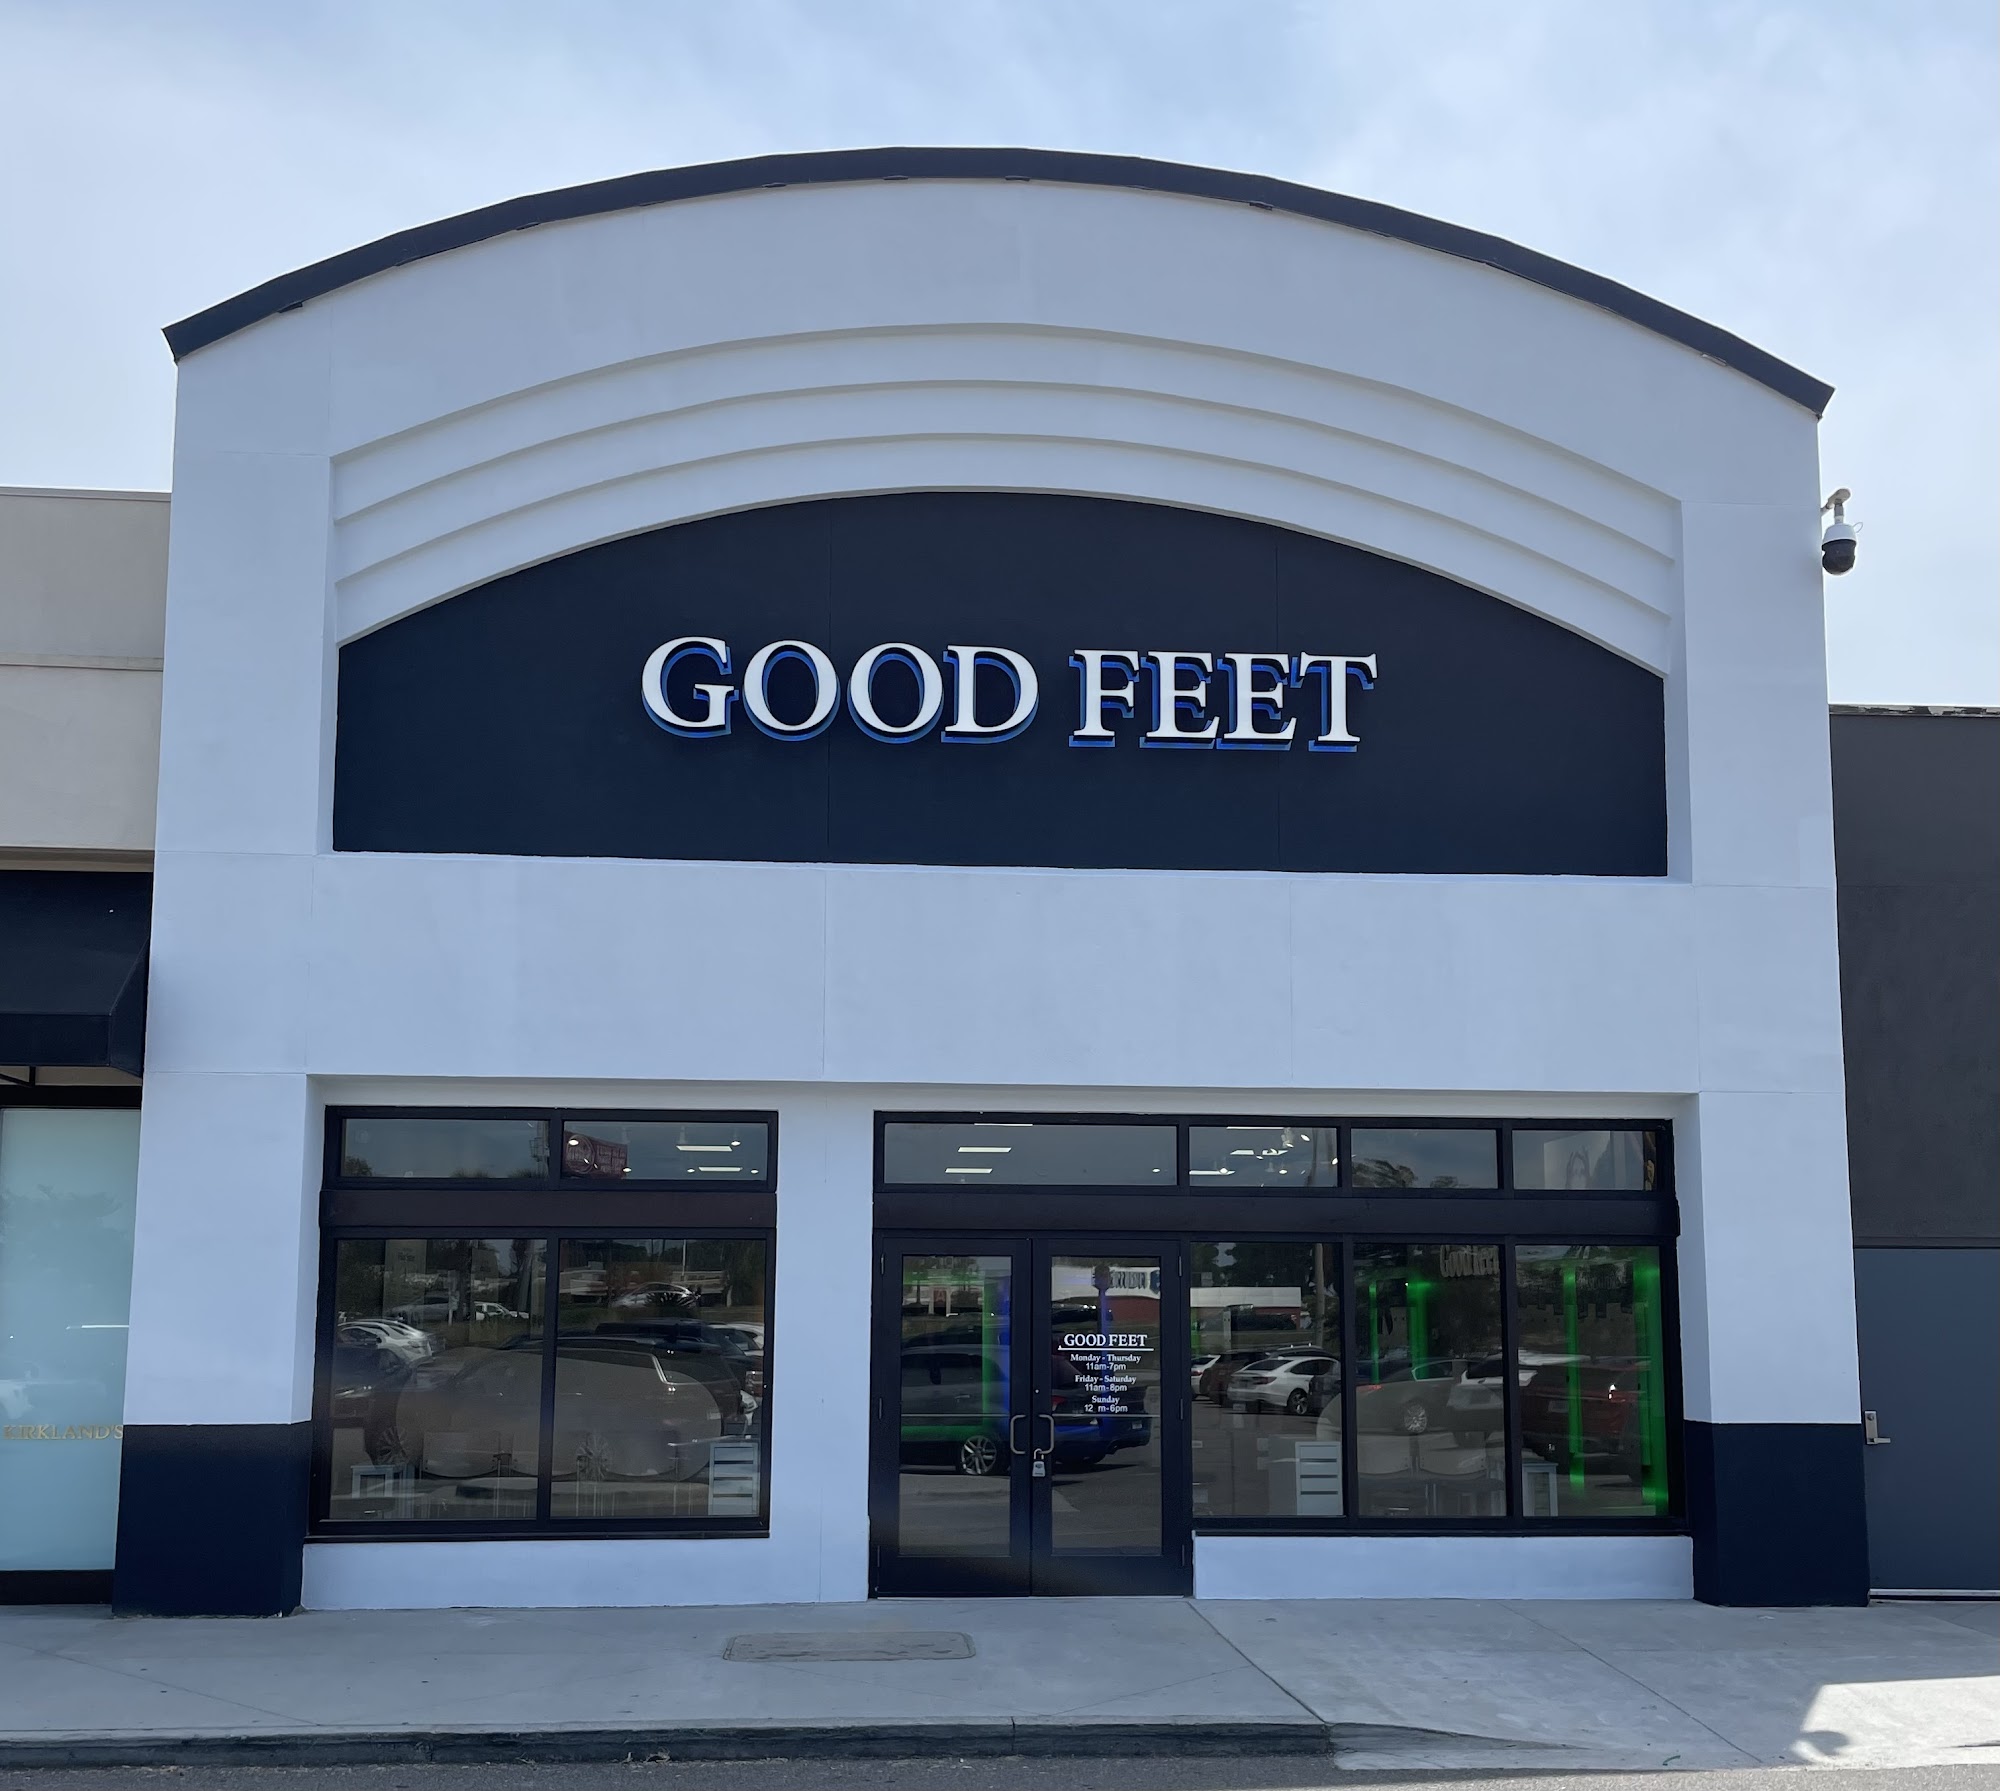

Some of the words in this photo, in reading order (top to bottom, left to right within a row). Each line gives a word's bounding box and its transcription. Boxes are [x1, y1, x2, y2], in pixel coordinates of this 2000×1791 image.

[640, 635, 1040, 743] GOOD
[1068, 648, 1378, 752] FEET
[1063, 1333, 1107, 1346] GOOD
[1108, 1334, 1148, 1347] FEET
[1070, 1354, 1101, 1363] Monday
[1106, 1354, 1141, 1363] Thursday
[1074, 1375, 1099, 1384] Friday
[1104, 1375, 1136, 1384] Saturday
[1091, 1395, 1119, 1405] Sunday
[3, 1424, 124, 1440] KIRKLAND'S
